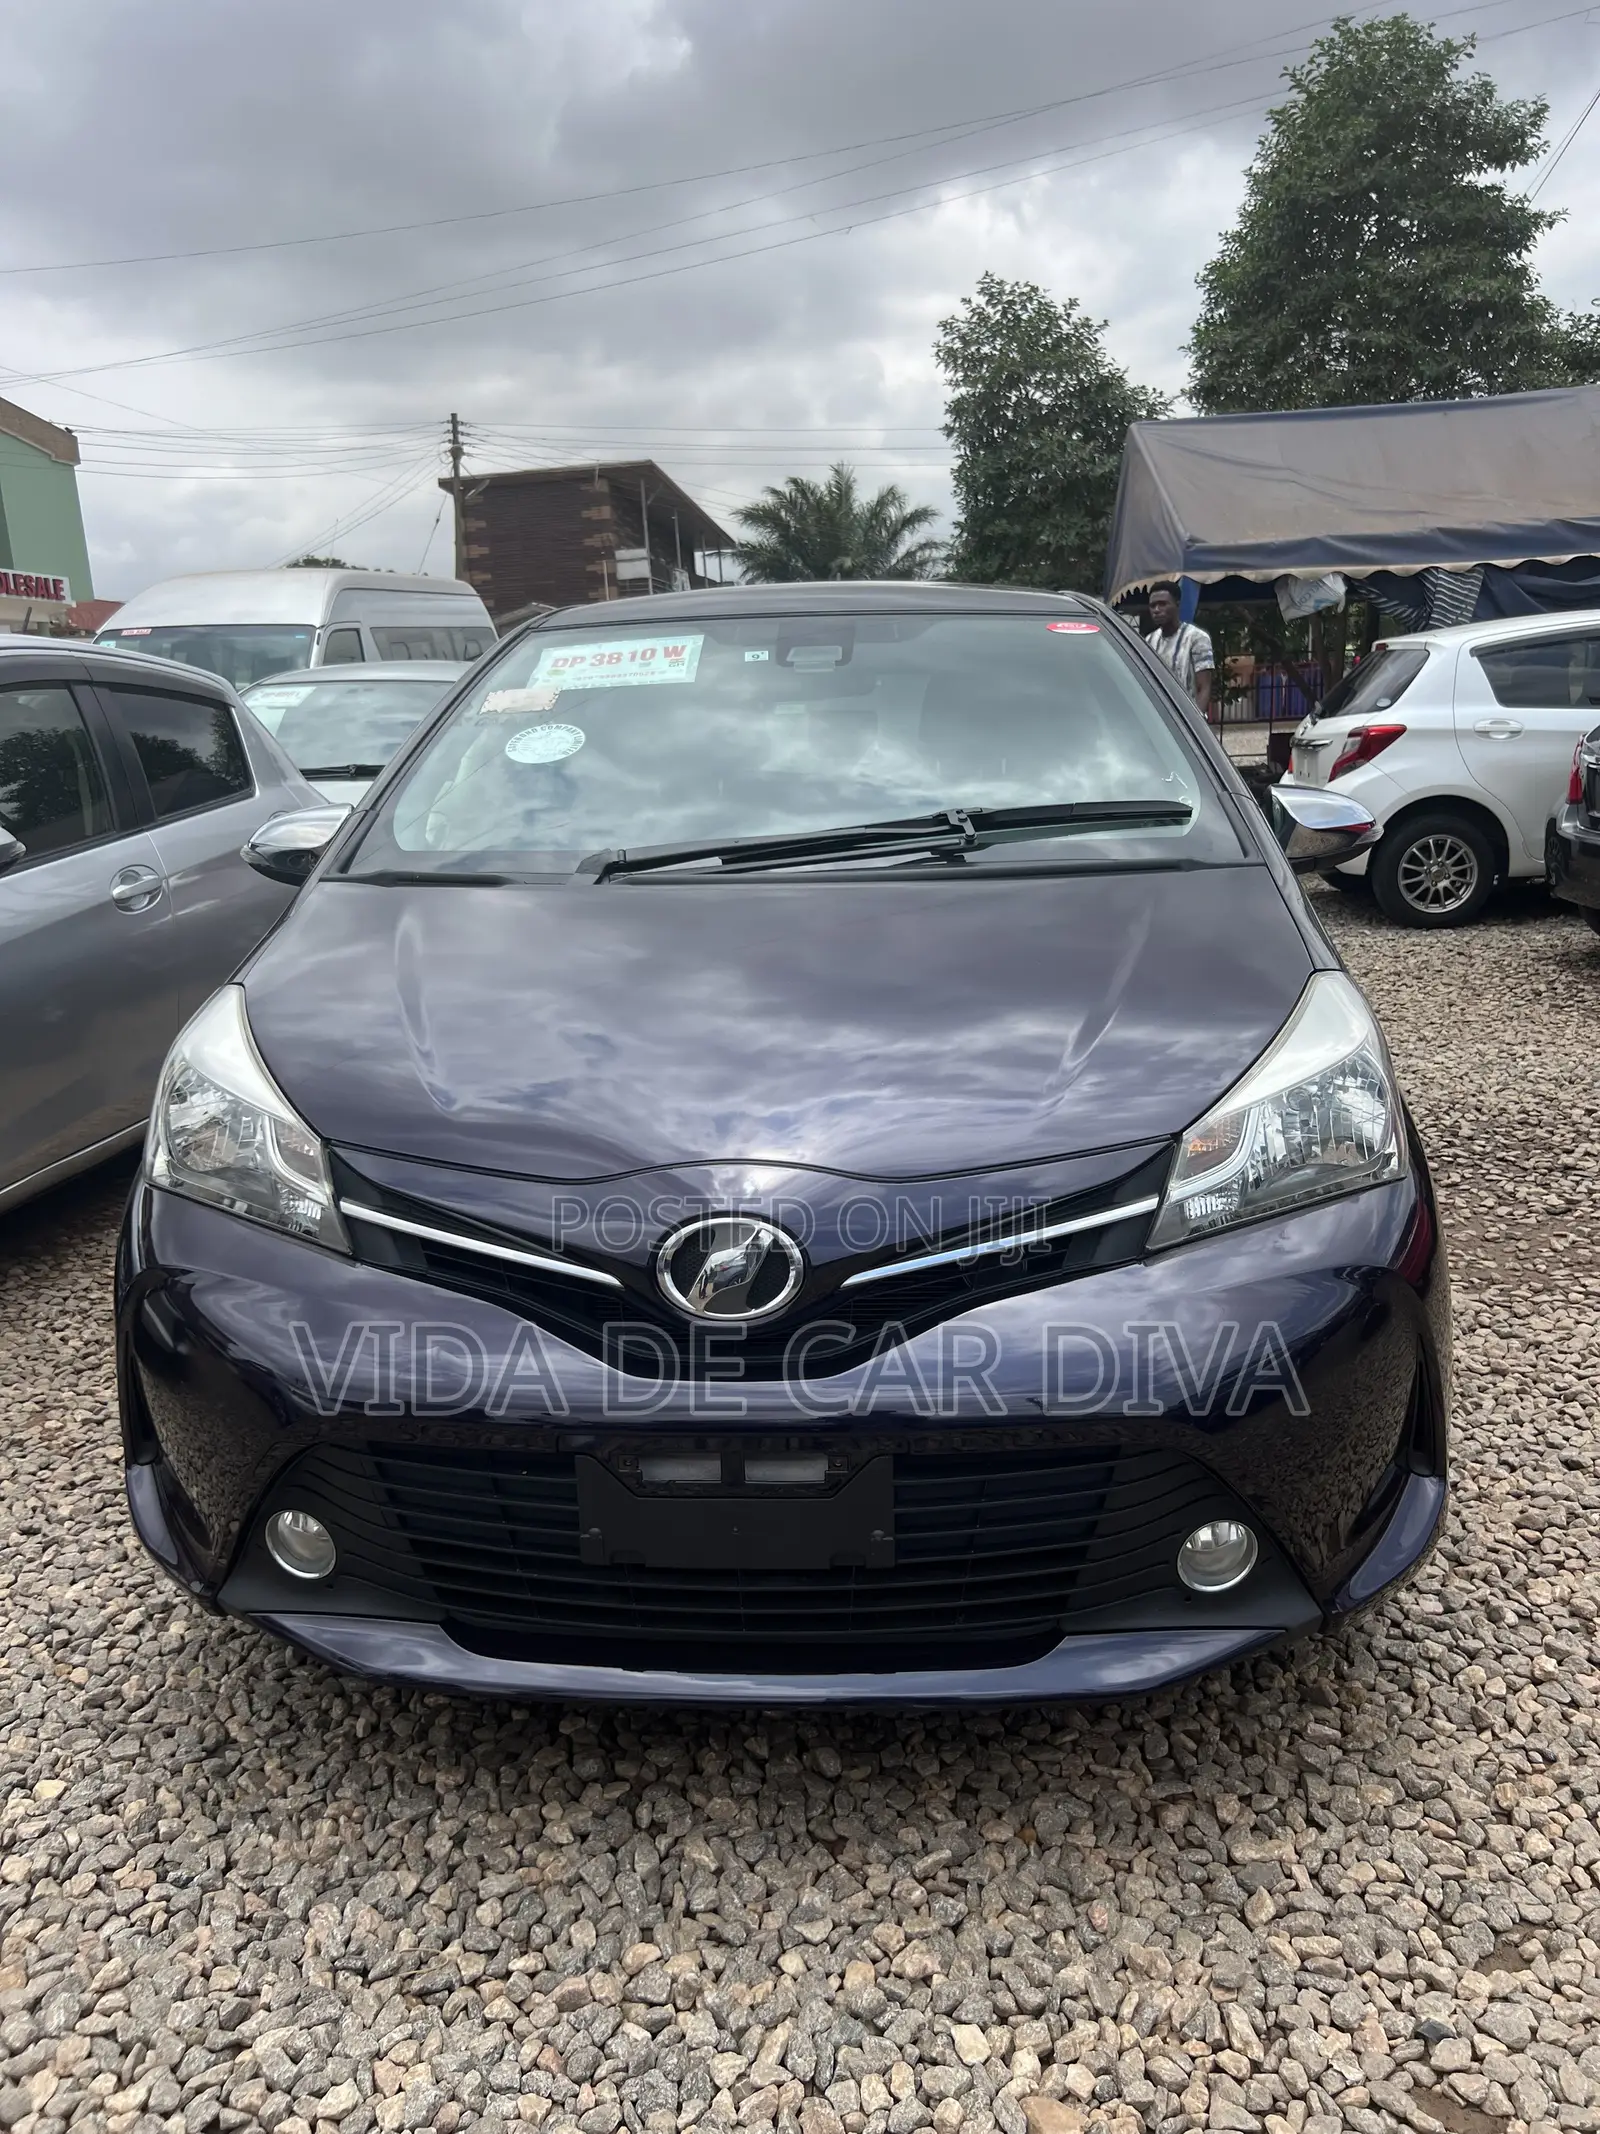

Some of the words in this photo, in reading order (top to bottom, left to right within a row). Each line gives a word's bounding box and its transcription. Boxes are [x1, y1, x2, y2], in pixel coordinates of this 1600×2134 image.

[550, 656, 587, 668] DP
[663, 645, 688, 658] W
[540, 724, 582, 736] COMPANY
